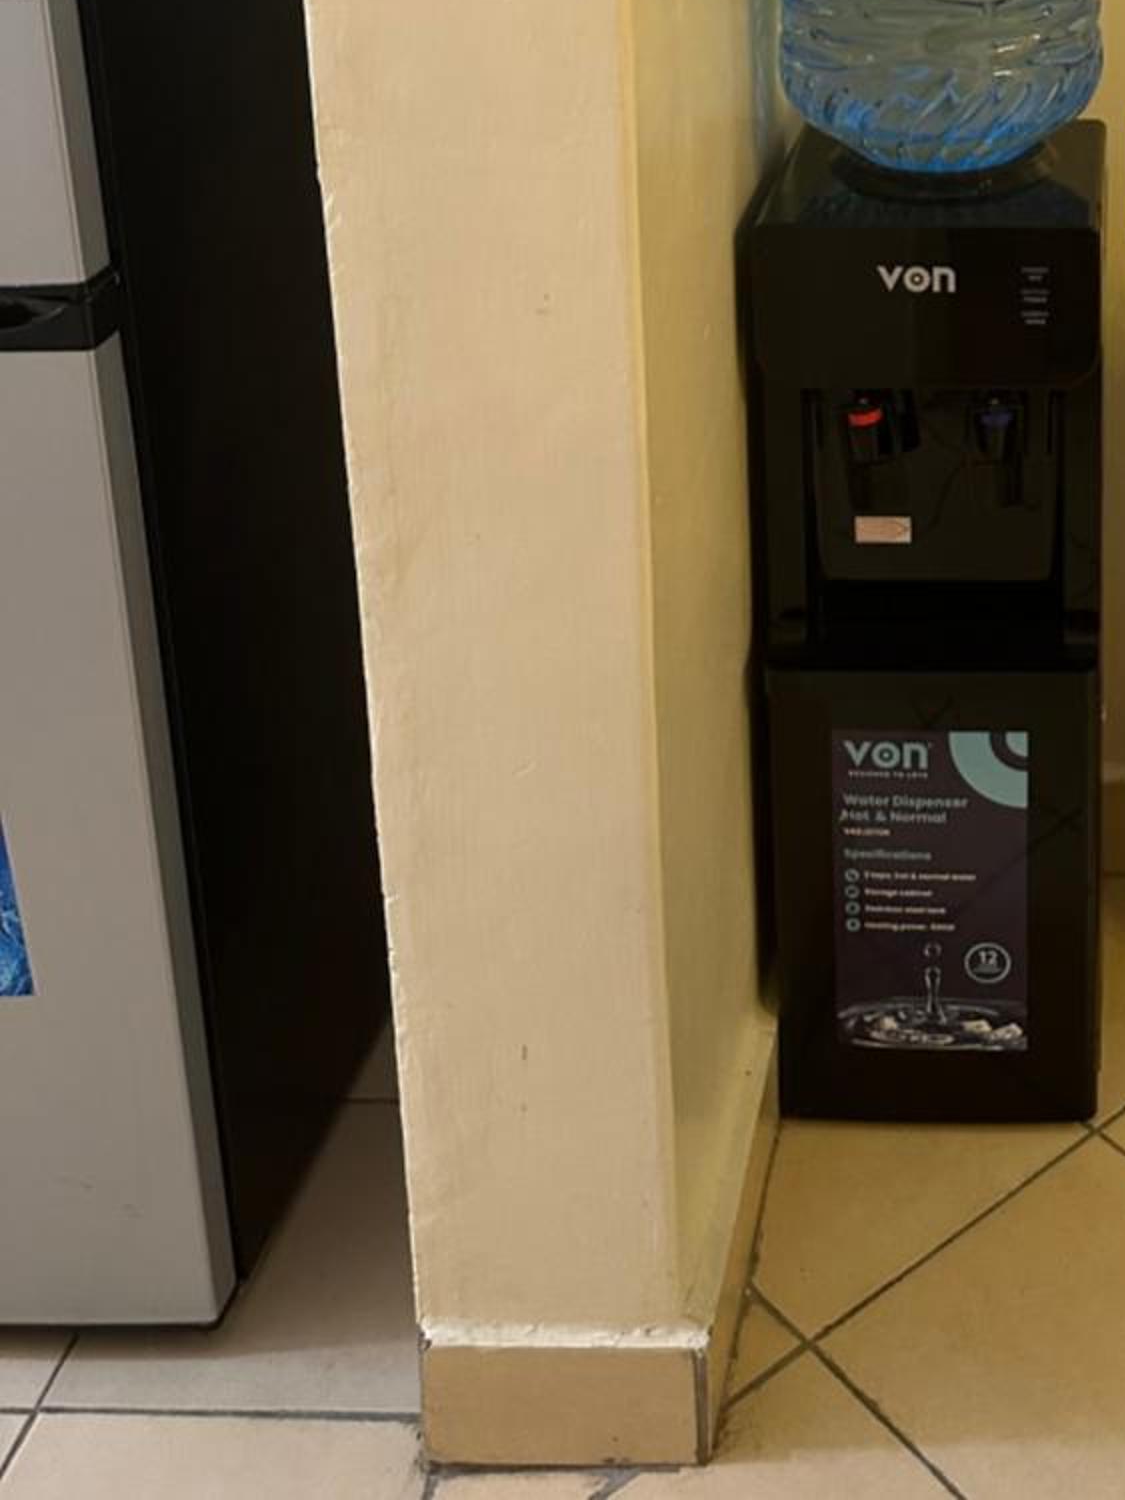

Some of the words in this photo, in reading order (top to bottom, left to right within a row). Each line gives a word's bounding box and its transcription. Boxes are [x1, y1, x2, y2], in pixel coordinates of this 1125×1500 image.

[877, 264, 956, 293] von
[843, 740, 929, 770] von
[843, 795, 889, 807] Water
[892, 795, 968, 811] Dispenser
[889, 811, 947, 824] Normal
